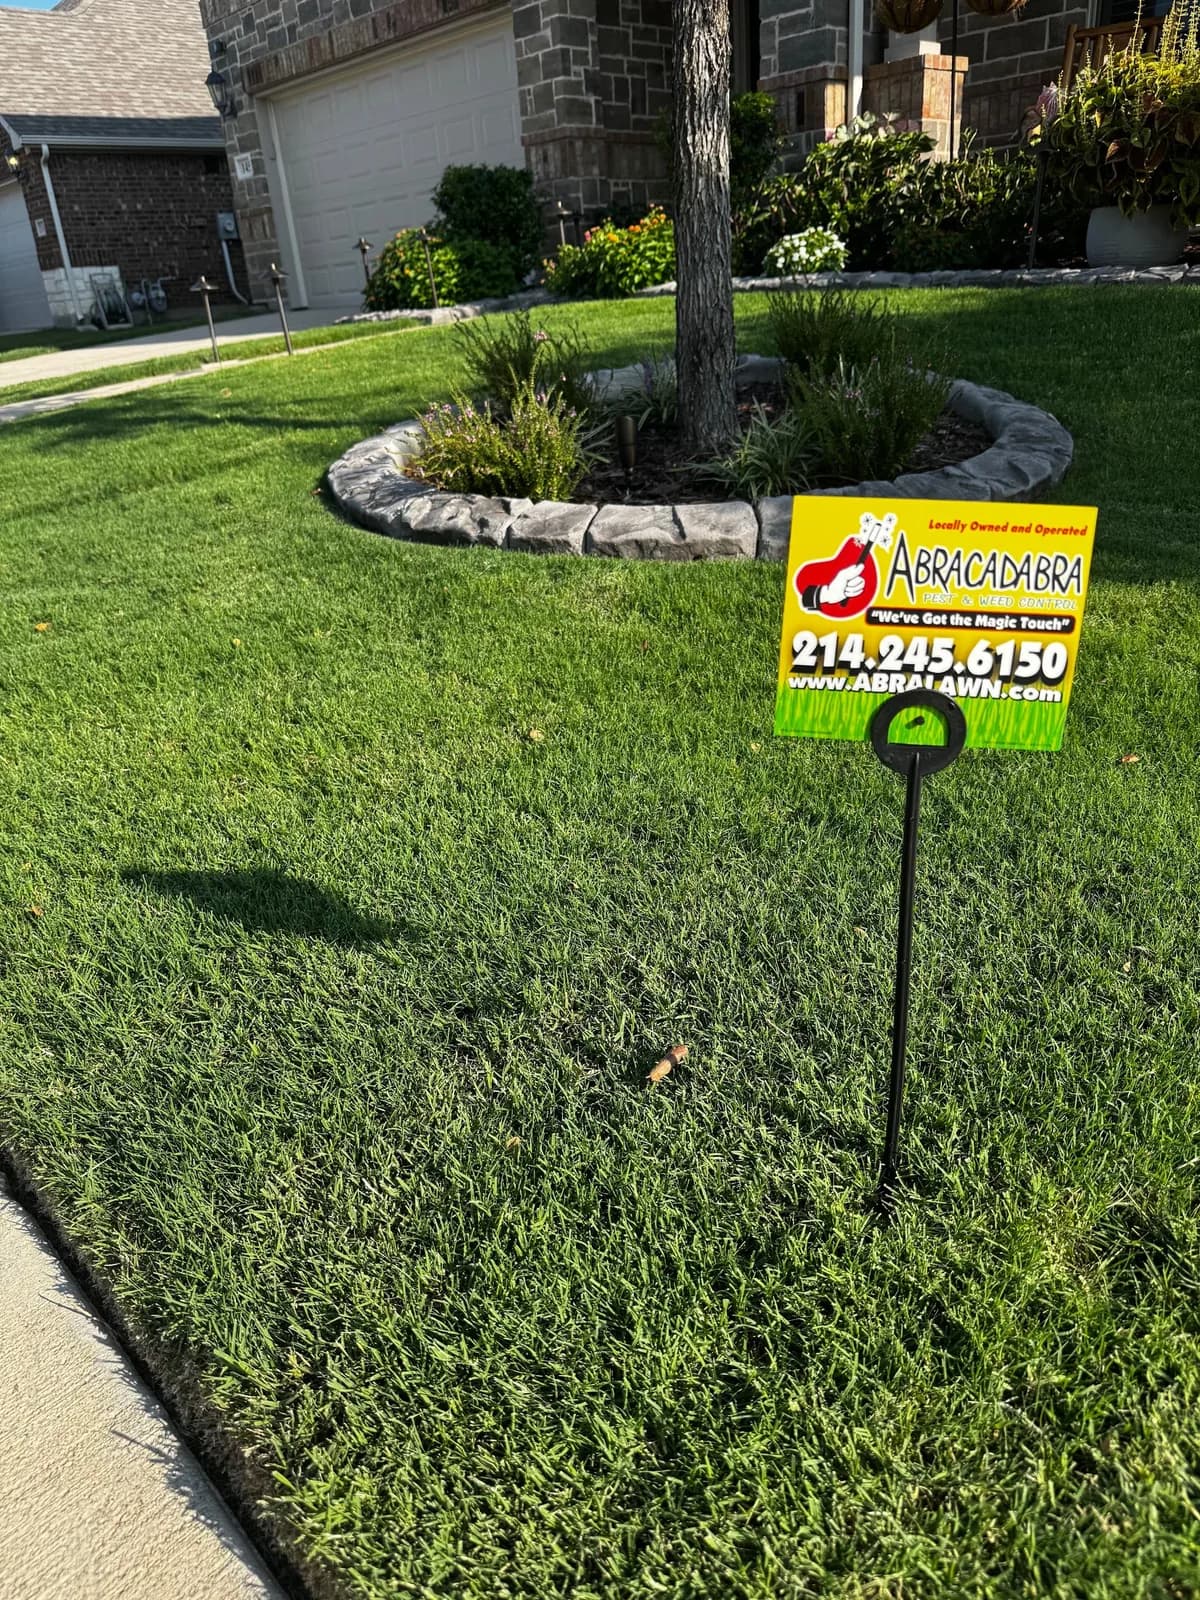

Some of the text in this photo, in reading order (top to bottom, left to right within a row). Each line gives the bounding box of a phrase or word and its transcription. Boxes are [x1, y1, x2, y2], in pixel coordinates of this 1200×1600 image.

[928, 519, 1088, 536] Locally Owned and Operated
[886, 531, 1082, 603] ABRACADABRA
[923, 593, 1077, 609] PEST & WEED CONTROL
[922, 612, 948, 625] Got
[949, 614, 972, 626] the
[975, 614, 1017, 630] Magic
[791, 630, 1068, 682] 214.245.6150
